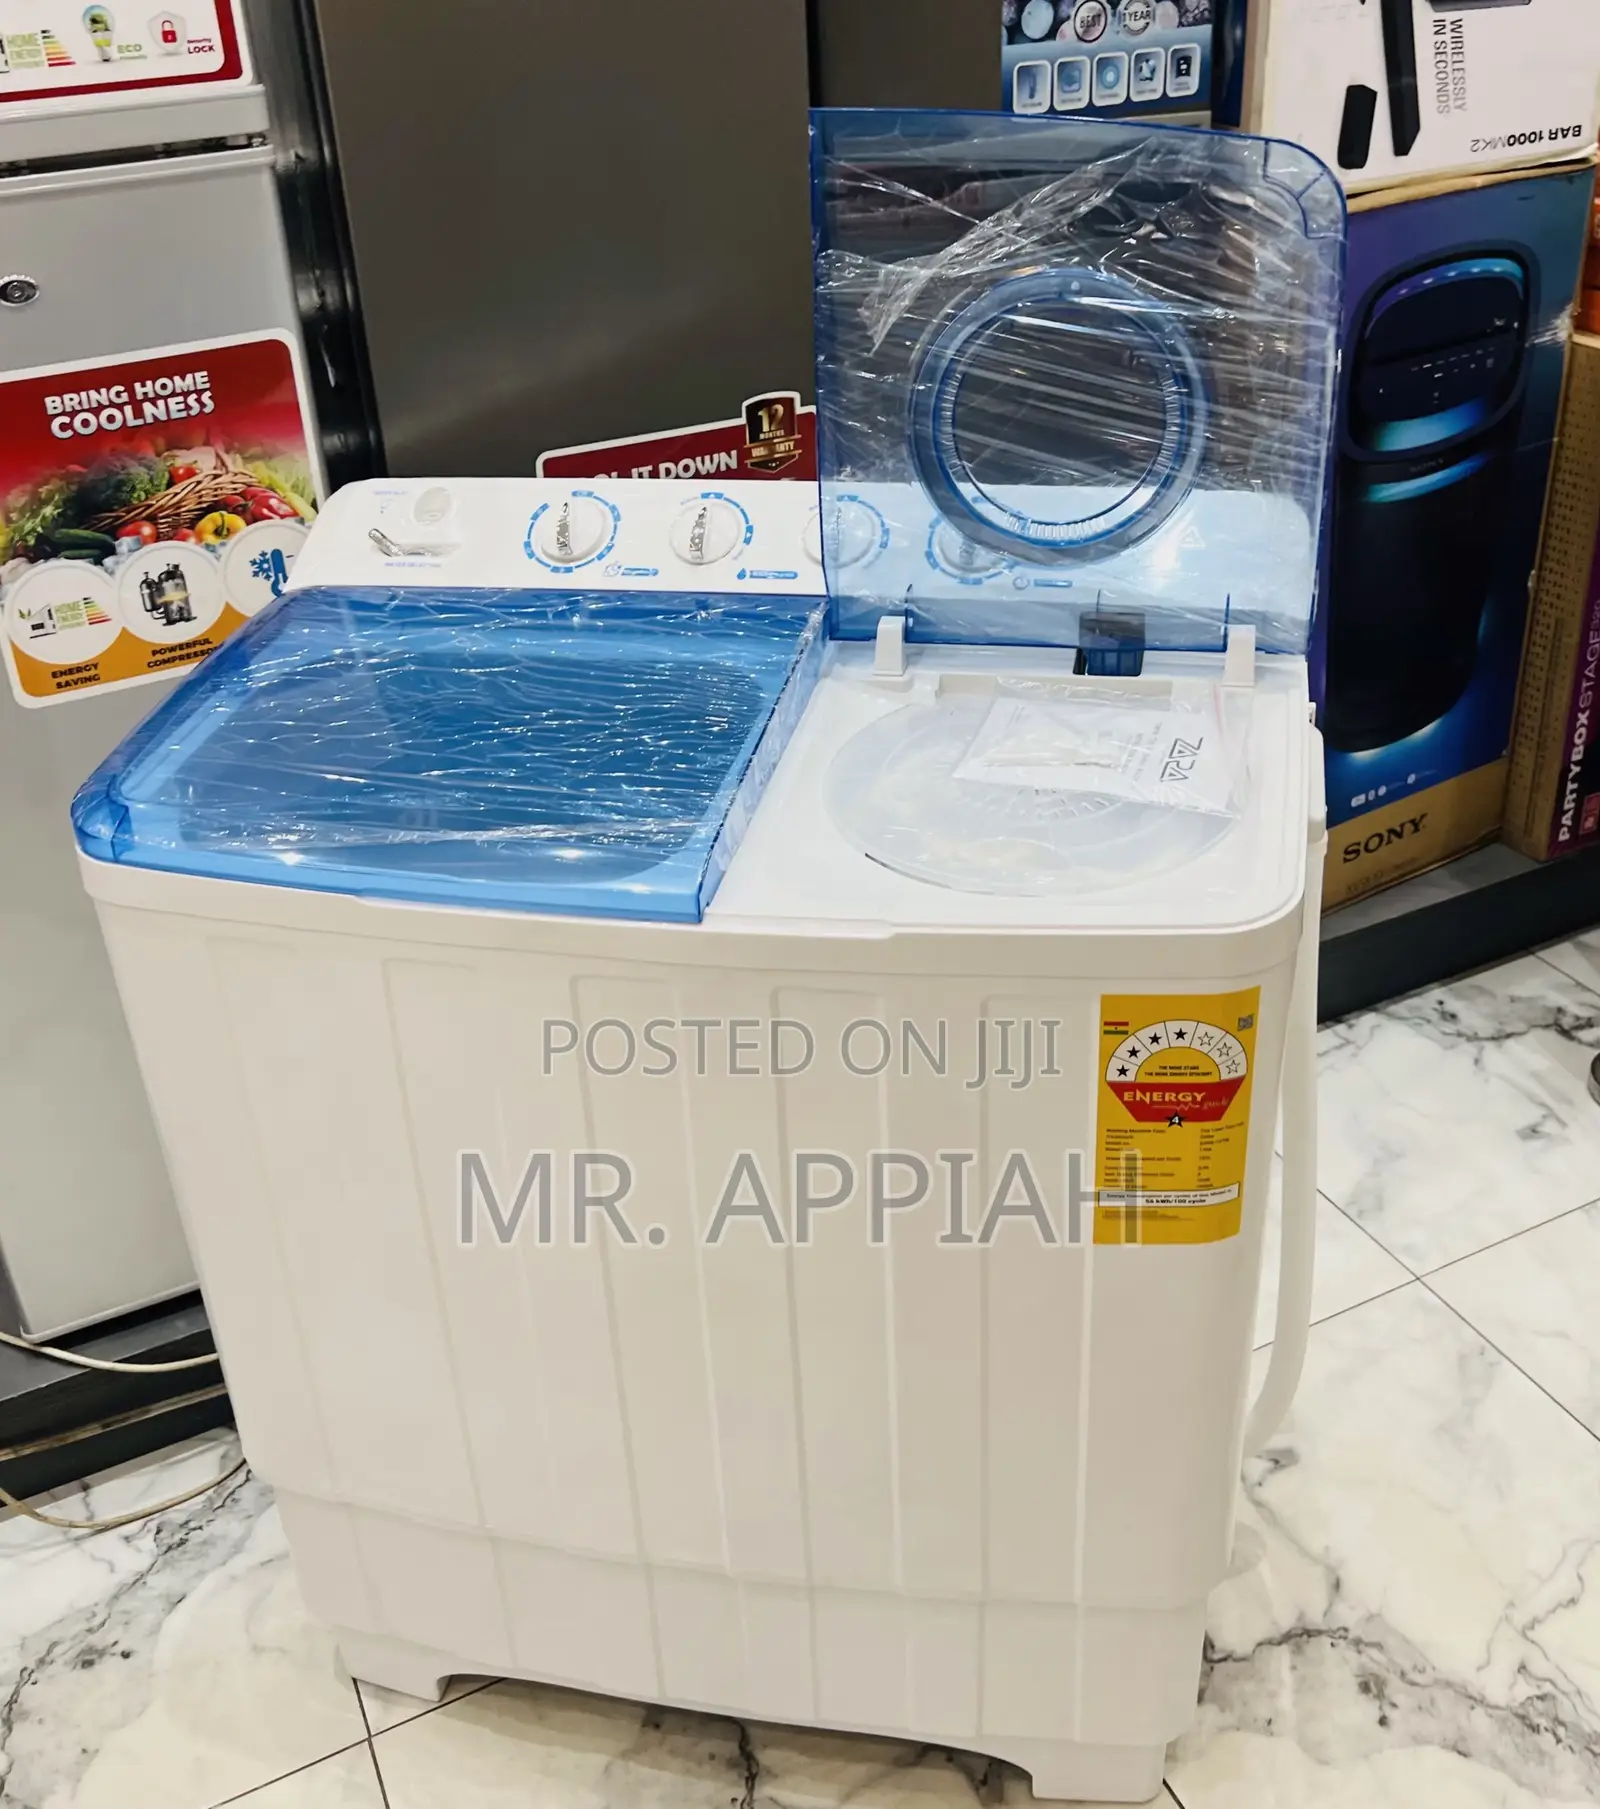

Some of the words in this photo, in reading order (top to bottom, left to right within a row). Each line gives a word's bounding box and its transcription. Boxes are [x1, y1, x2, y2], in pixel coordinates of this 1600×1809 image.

[1080, 13, 1102, 28] BEST
[1128, 10, 1151, 21] YEAR
[1433, 19, 1446, 36] IN
[117, 44, 142, 53] ECO
[187, 45, 215, 54] LOCK
[1450, 18, 1468, 112] WIRELESSLY
[1434, 39, 1450, 115] SECONDS
[1549, 125, 1582, 141] BAR
[44, 384, 129, 417] BRING
[134, 370, 211, 400] HOME
[50, 390, 216, 440] COOLNESS
[758, 404, 784, 433] 12
[751, 440, 795, 458] WAANTY
[658, 450, 738, 479] DOWN
[151, 637, 213, 658] POWERFUL
[51, 662, 99, 679] ENERGY
[56, 673, 101, 689] SAVING
[1343, 812, 1428, 864] SONY
[1123, 1089, 1206, 1104] ENERGY
[1172, 1116, 1179, 1124] 4
